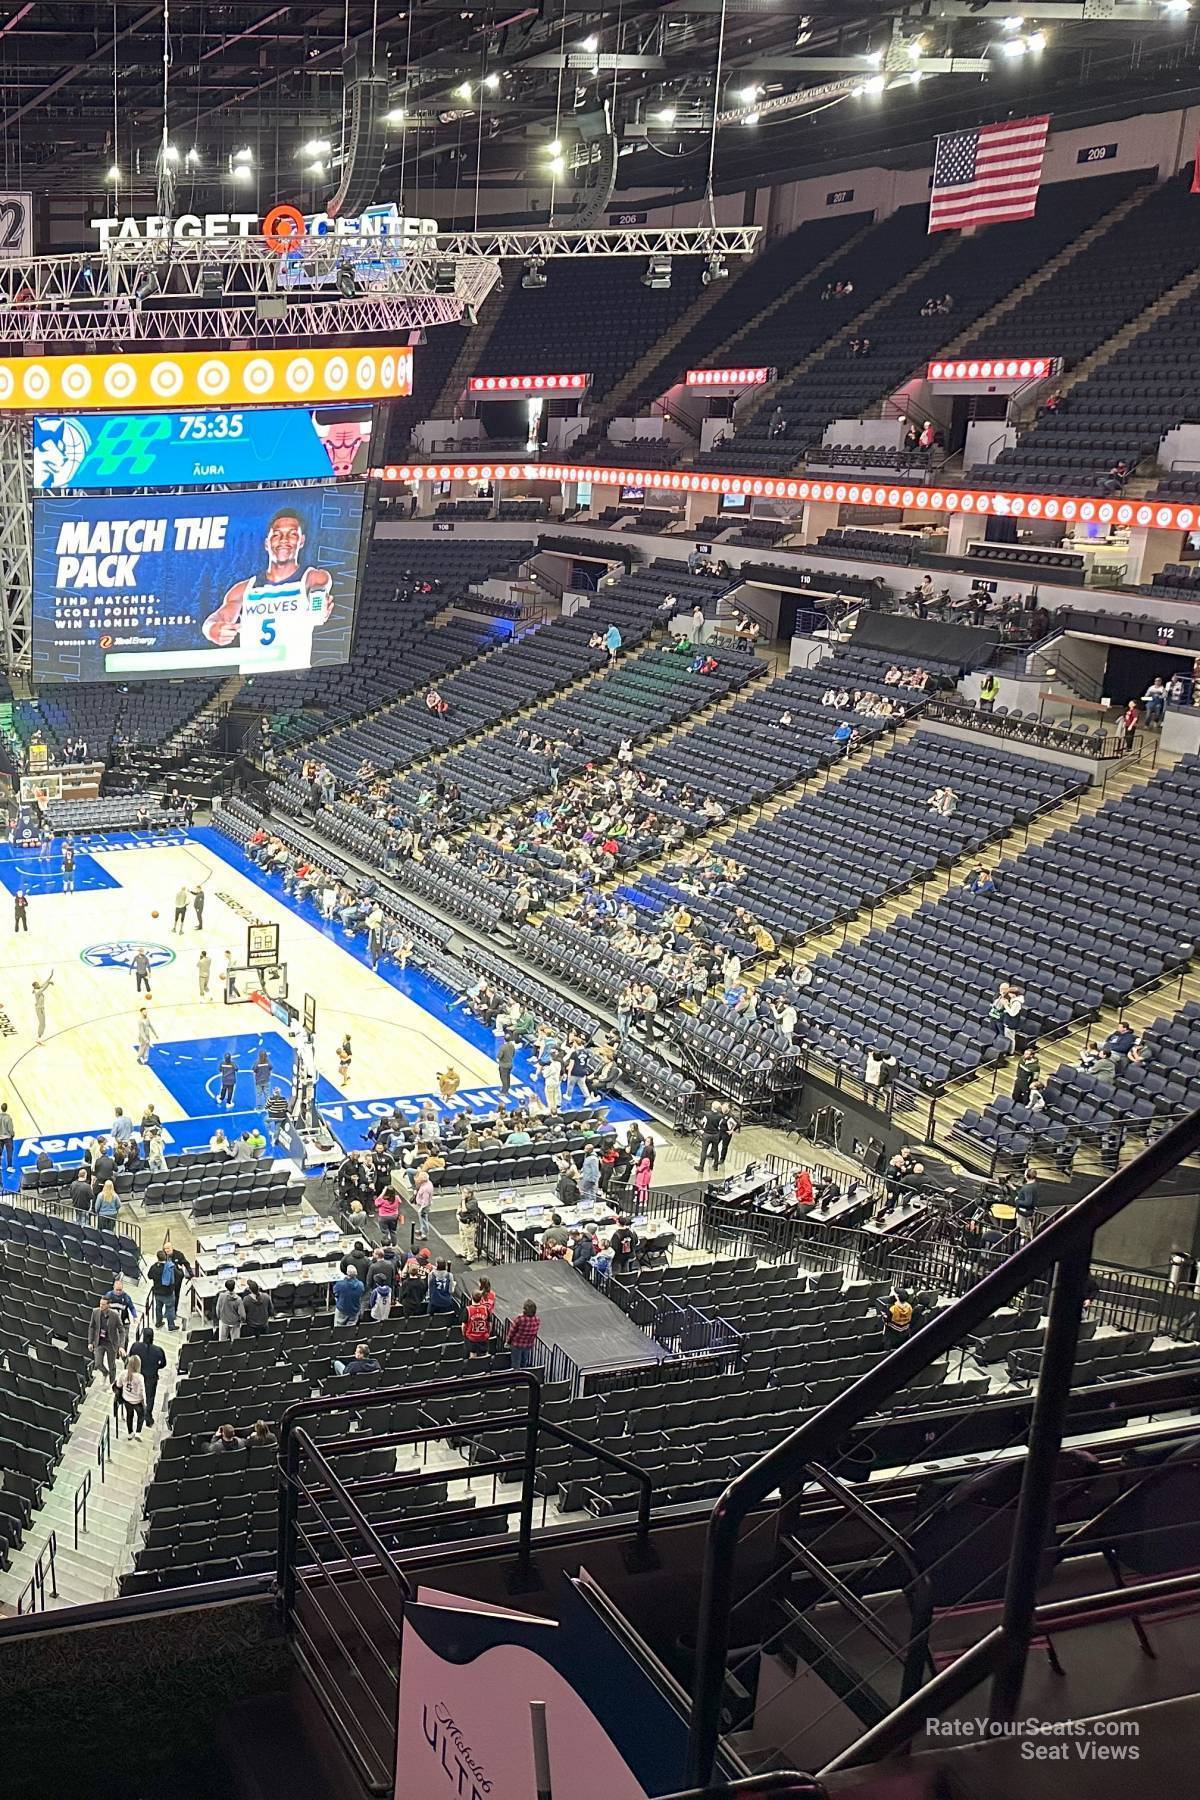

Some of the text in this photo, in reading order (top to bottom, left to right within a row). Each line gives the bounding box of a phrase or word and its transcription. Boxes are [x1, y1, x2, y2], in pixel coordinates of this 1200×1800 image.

[1087, 146, 1106, 160] 209
[833, 191, 847, 203] 207
[619, 214, 637, 224] 206
[91, 213, 439, 250] TARGET CENTER
[178, 415, 245, 440] 75:35
[55, 516, 229, 555] MATCH THE
[55, 555, 141, 588] PACK
[800, 575, 810, 584] 110
[55, 595, 160, 606] FIND MATCHES.
[55, 606, 159, 617] SCORE POINTS.
[245, 600, 298, 615] WOLVES
[54, 615, 197, 629] WIN SIGNED PRIZES.
[259, 618, 277, 647] 5
[1157, 626, 1175, 638] 112
[436, 1280, 448, 1291] 21
[472, 1321, 486, 1332] 12
[126, 1383, 133, 1393] 5
[925, 1432, 935, 1440] 10
[434, 1701, 494, 1793] Michelob
